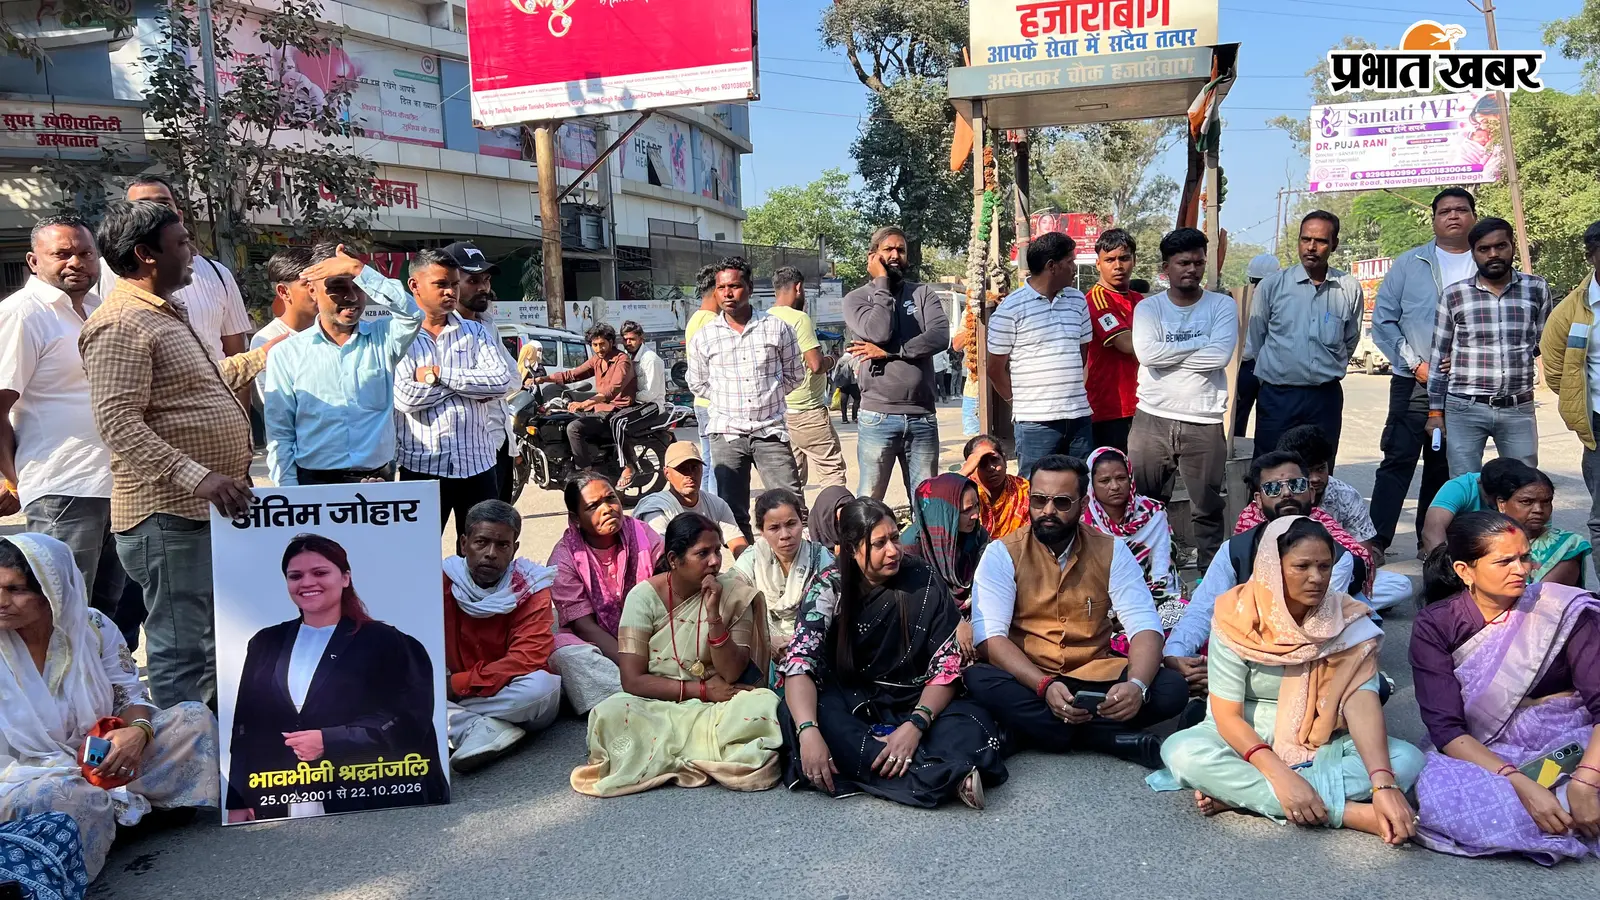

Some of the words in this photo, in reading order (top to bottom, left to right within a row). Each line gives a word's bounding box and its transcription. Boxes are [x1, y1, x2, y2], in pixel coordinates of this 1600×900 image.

[987, 38, 1039, 64] आपके
[1045, 36, 1078, 58] सेवा
[1084, 32, 1100, 54] में
[1108, 29, 1148, 52] सदैव
[1154, 28, 1198, 47] तत्पर
[987, 67, 1062, 91] अम्बेदकर
[1068, 62, 1105, 85] चौक
[1110, 55, 1195, 78] हजारीबाग
[2, 113, 35, 132] सुपर
[42, 112, 122, 132] स्पेशियलिटी
[1347, 103, 1414, 125] Santati
[36, 133, 100, 148] अस्पताल
[1316, 142, 1332, 151] DR.
[1334, 140, 1360, 150] PUJA
[1362, 138, 1387, 148] RANI
[1335, 179, 1358, 188] Tower
[1359, 177, 1382, 187] Road,
[1384, 174, 1432, 187] Nawabganj,
[1435, 173, 1483, 183] Hazaribagh
[231, 494, 322, 529] अंतिम
[326, 492, 421, 526] जोहार
[248, 759, 335, 789] भावभीनी
[338, 752, 431, 782] श्रद्धांजलि
[260, 789, 333, 806] 25.02.2001
[336, 785, 348, 799] से
[350, 782, 422, 799] 22.10.2026
